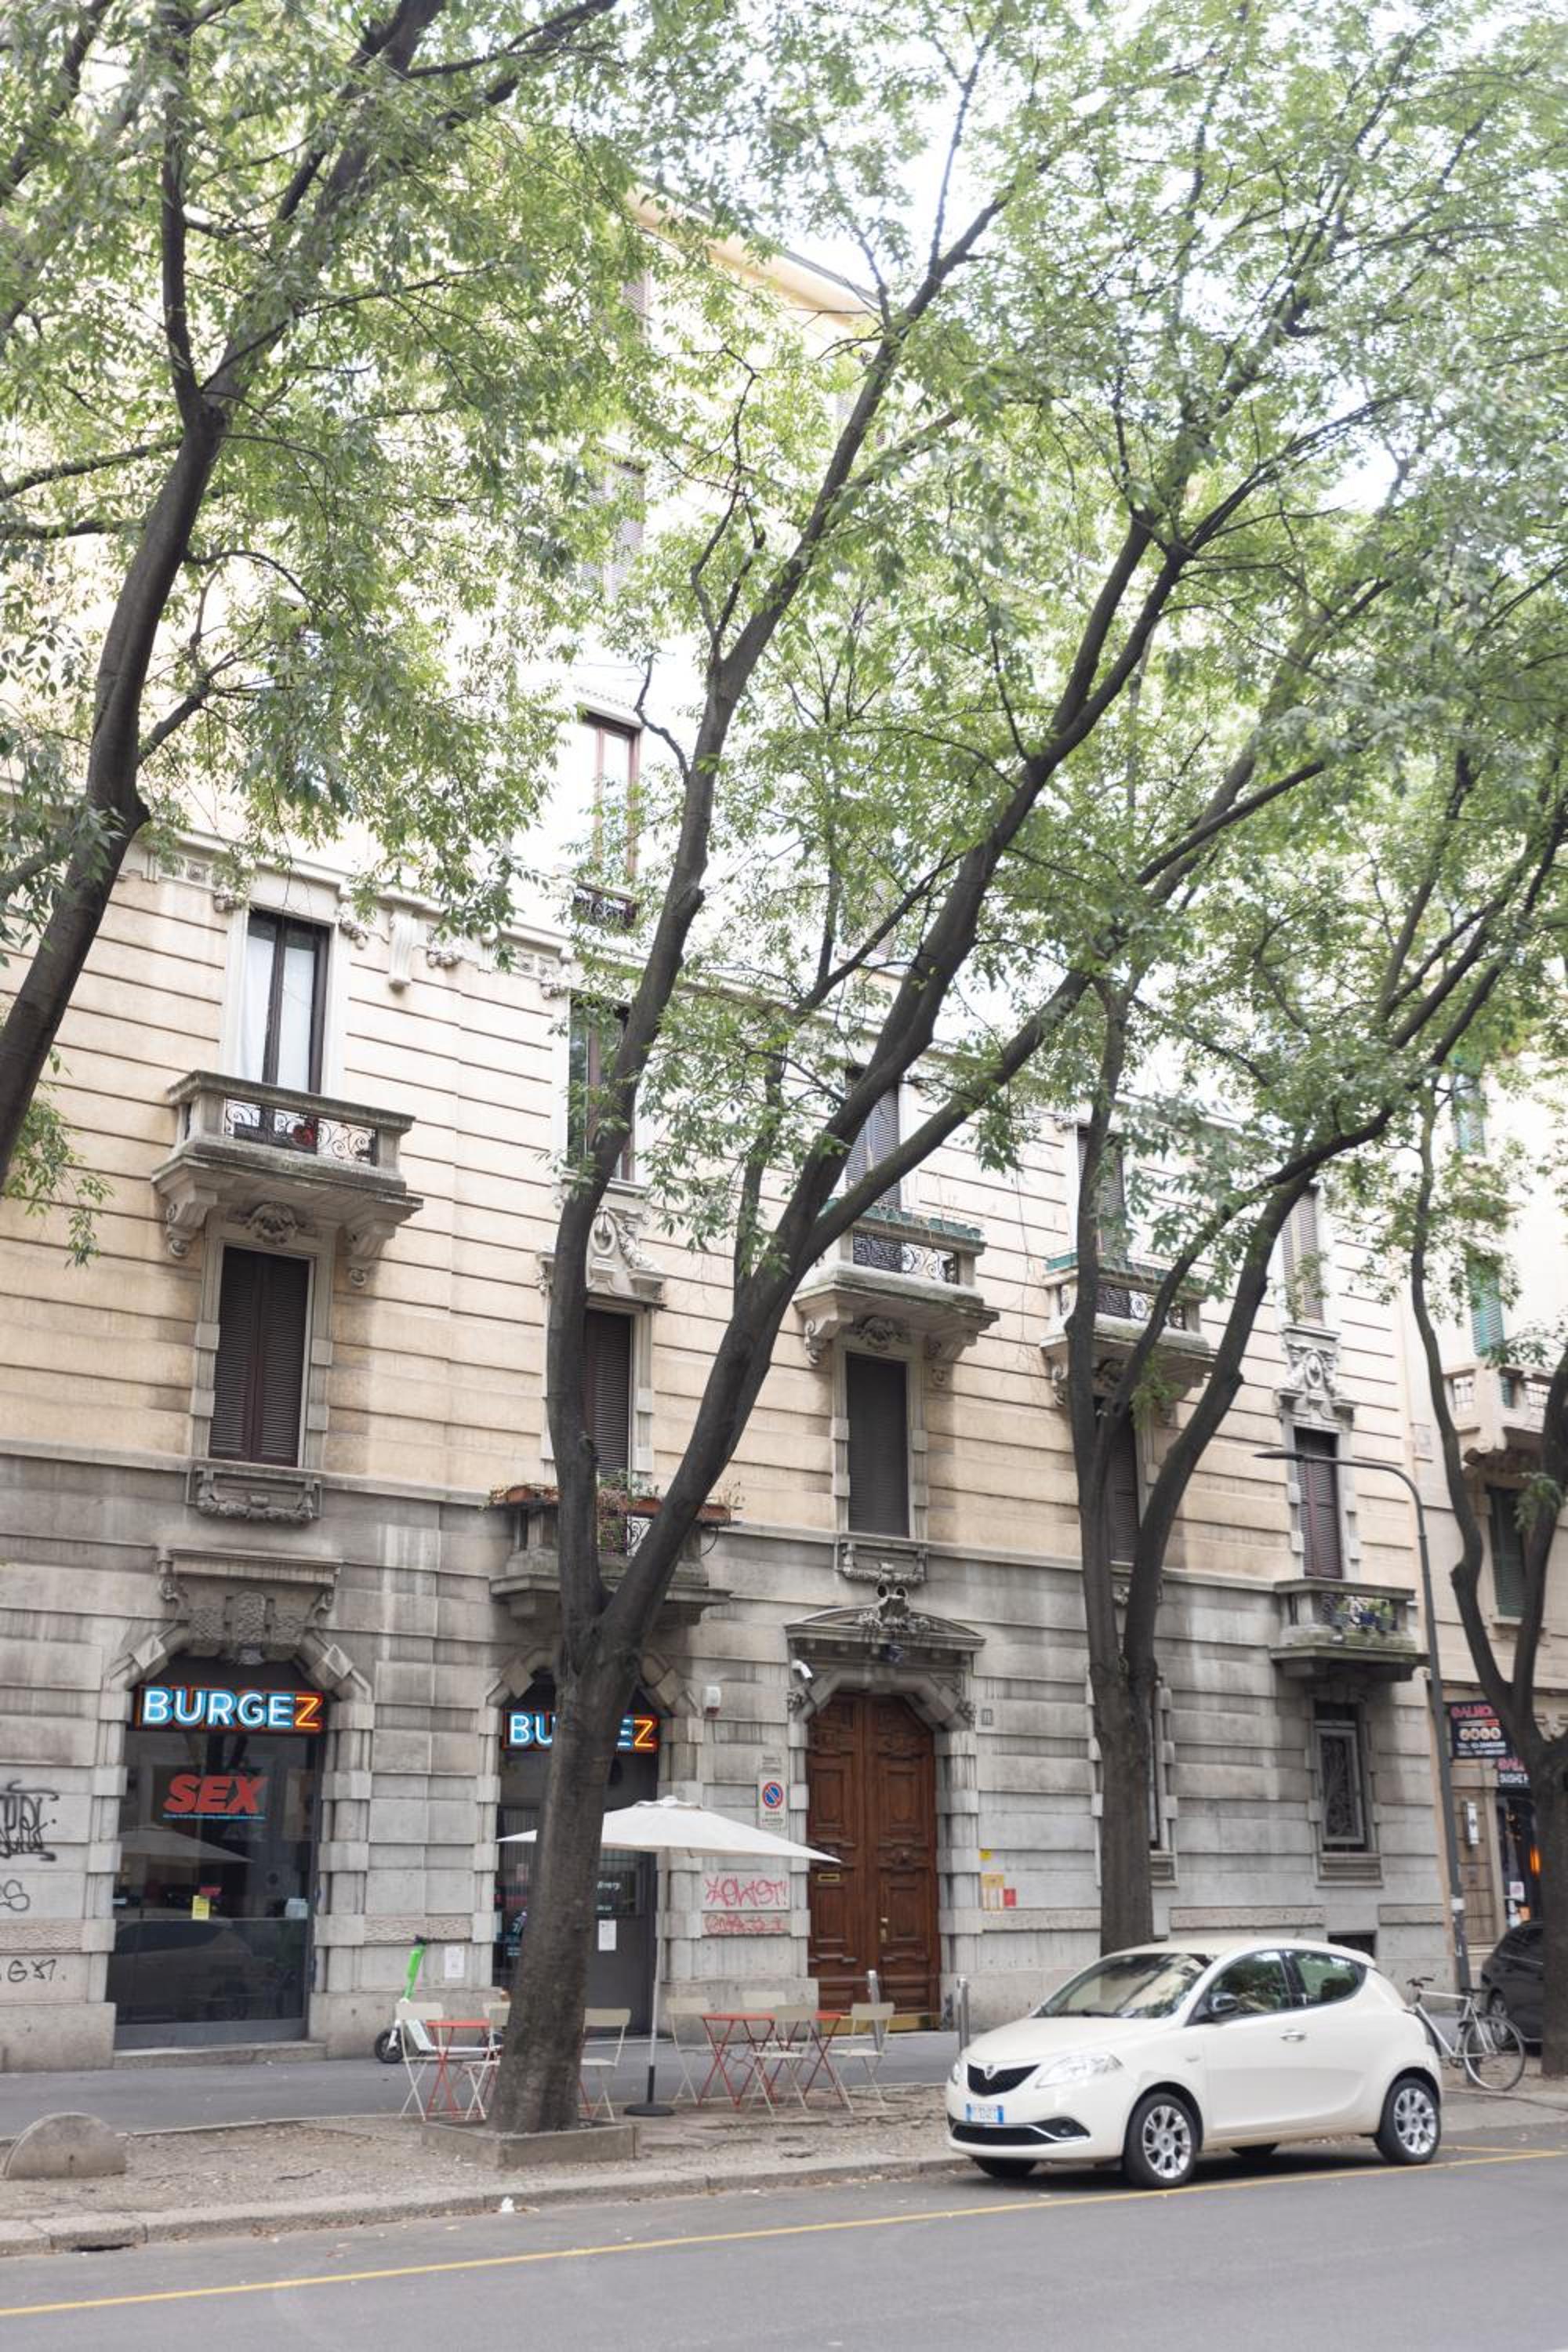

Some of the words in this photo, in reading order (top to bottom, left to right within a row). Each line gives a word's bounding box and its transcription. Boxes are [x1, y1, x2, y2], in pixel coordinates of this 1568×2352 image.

[142, 1687, 324, 1731] BURGEZ
[510, 1711, 657, 1753] BUEZ
[163, 1773, 269, 1814] SEX
